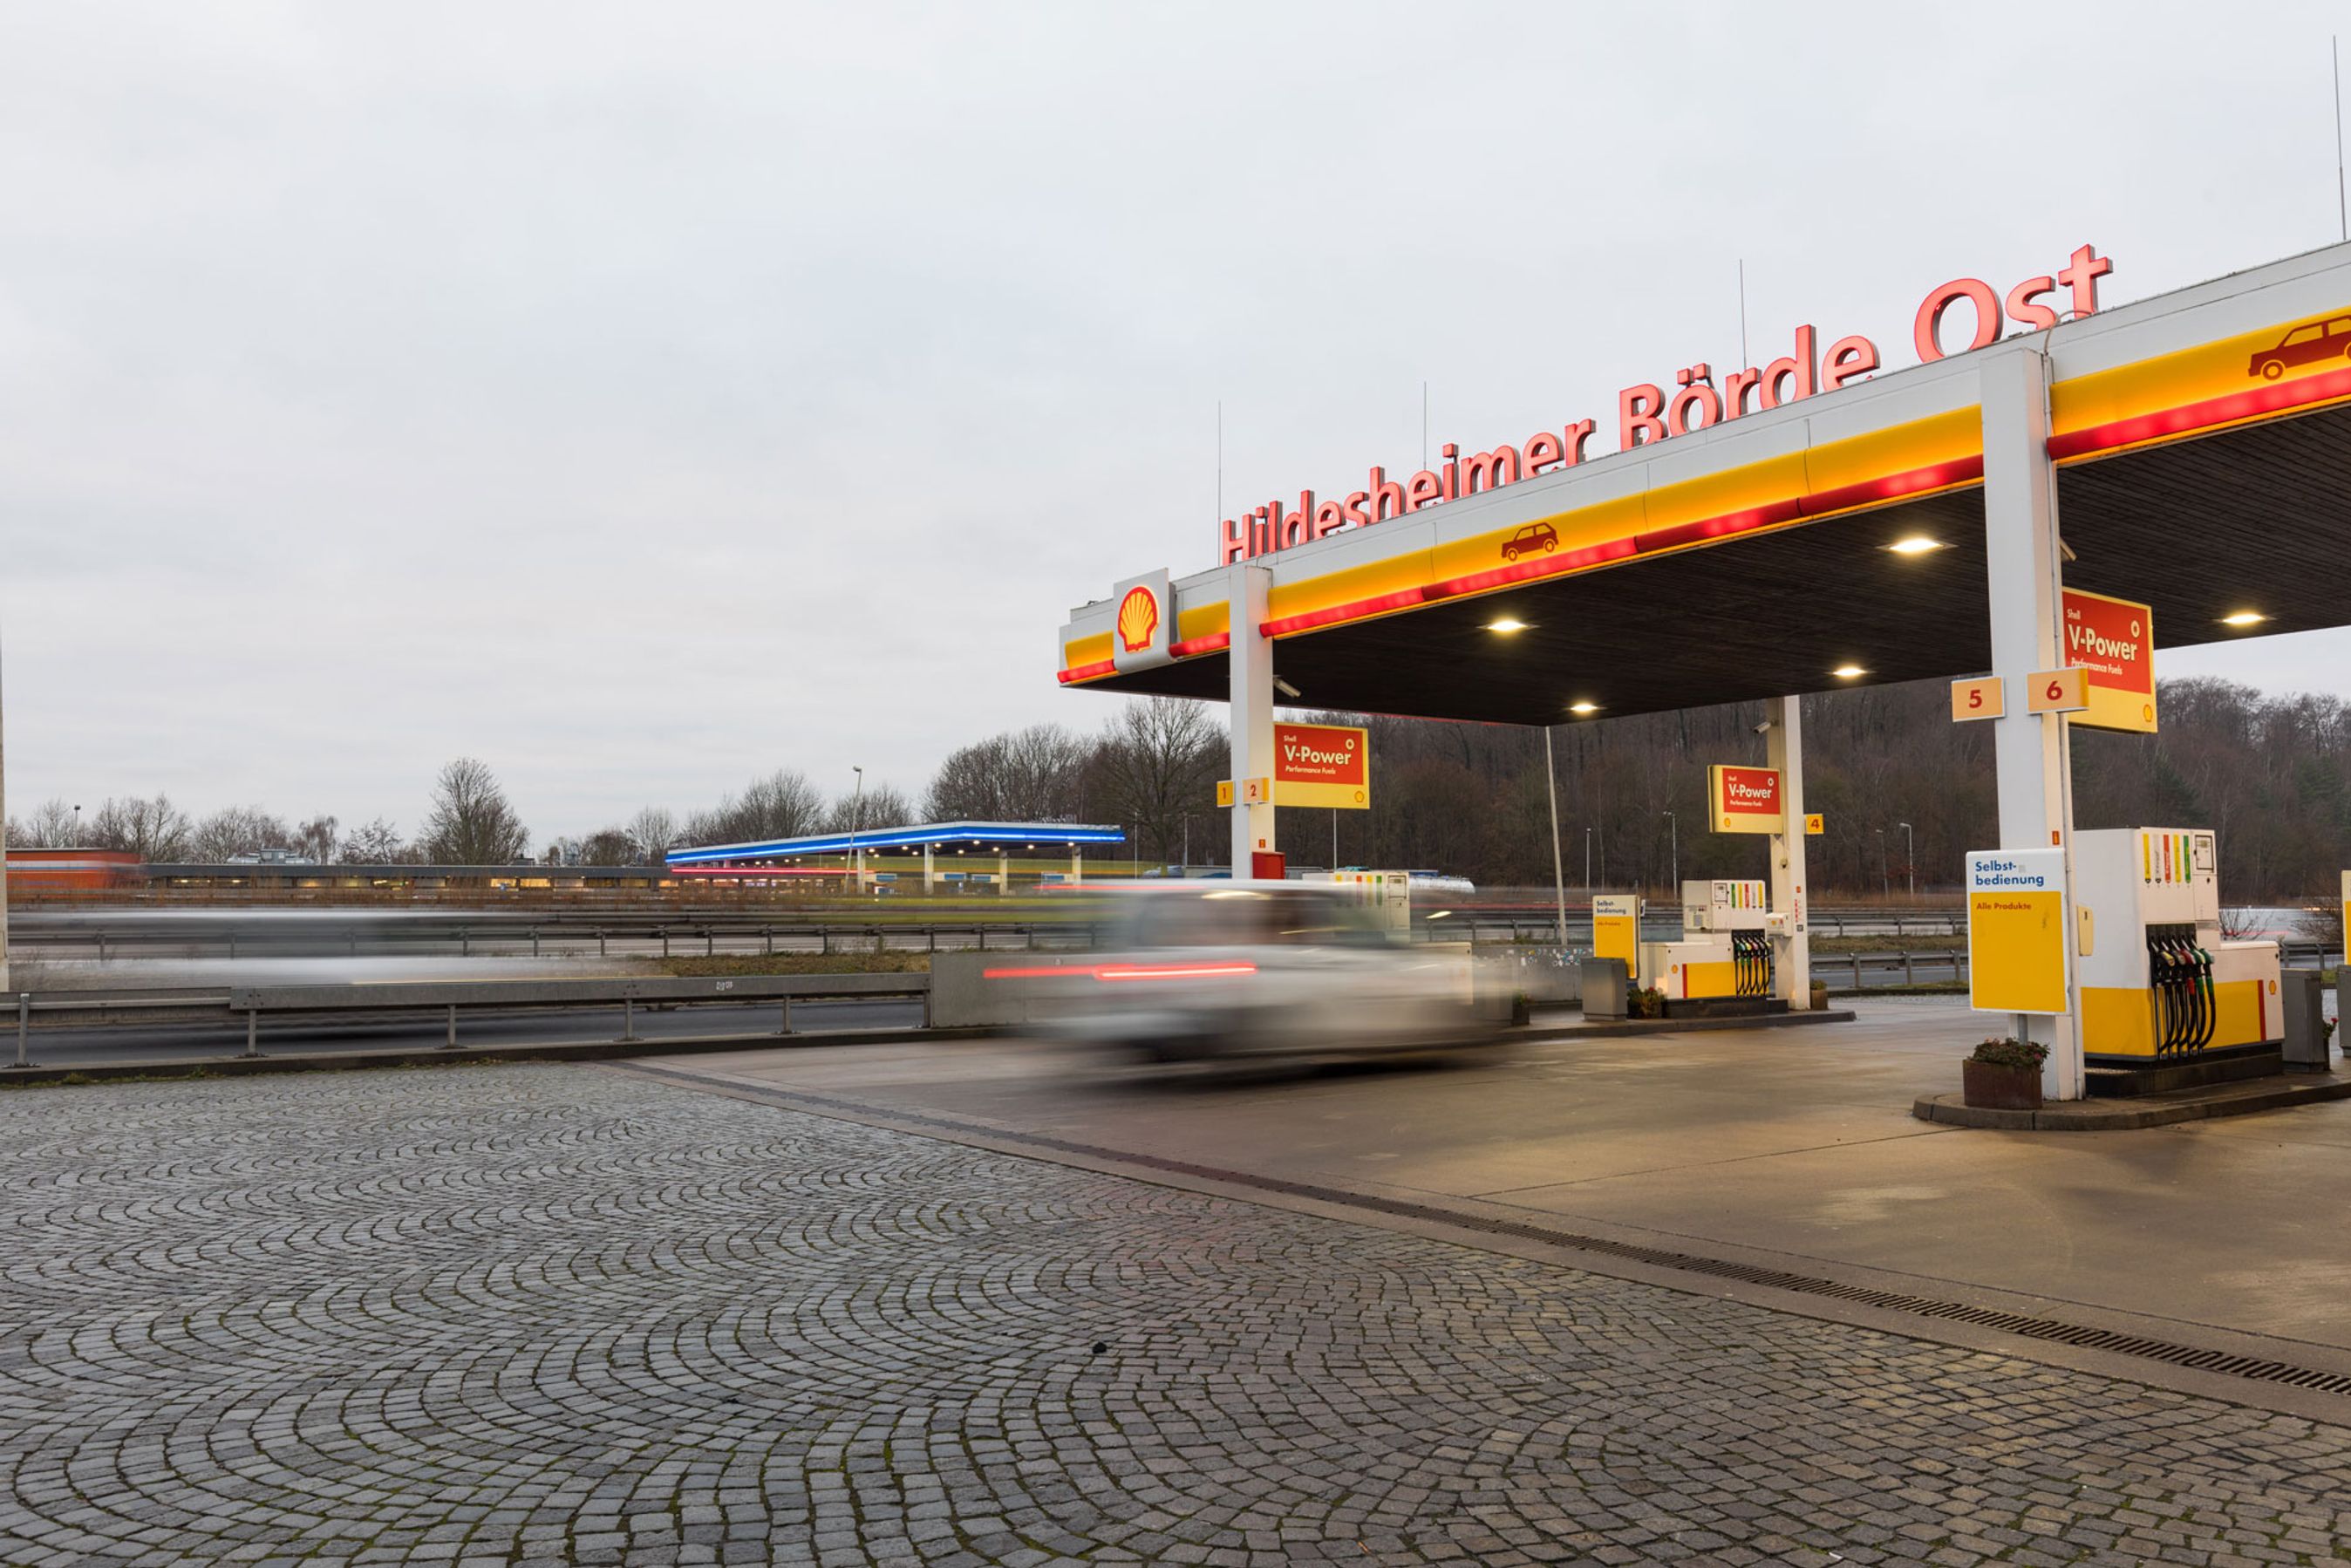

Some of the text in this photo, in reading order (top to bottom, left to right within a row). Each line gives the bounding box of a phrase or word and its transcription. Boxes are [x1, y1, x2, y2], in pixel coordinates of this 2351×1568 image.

[1223, 244, 2114, 566] Hildesheimer Börde Ost
[2068, 624, 2137, 661] V-Power
[2046, 680, 2063, 700] 6
[1968, 689, 1982, 709] 5
[1284, 745, 1352, 765] V-Power
[1285, 765, 1321, 774] Performance
[1223, 787, 1227, 799] 1
[1250, 784, 1257, 797] 2
[1728, 783, 1772, 799] V-Power
[1810, 819, 1820, 829] 4
[1975, 860, 2017, 872] Selbst-
[1975, 874, 2045, 887] bedienung
[1976, 902, 2032, 910] Alle Produkte
